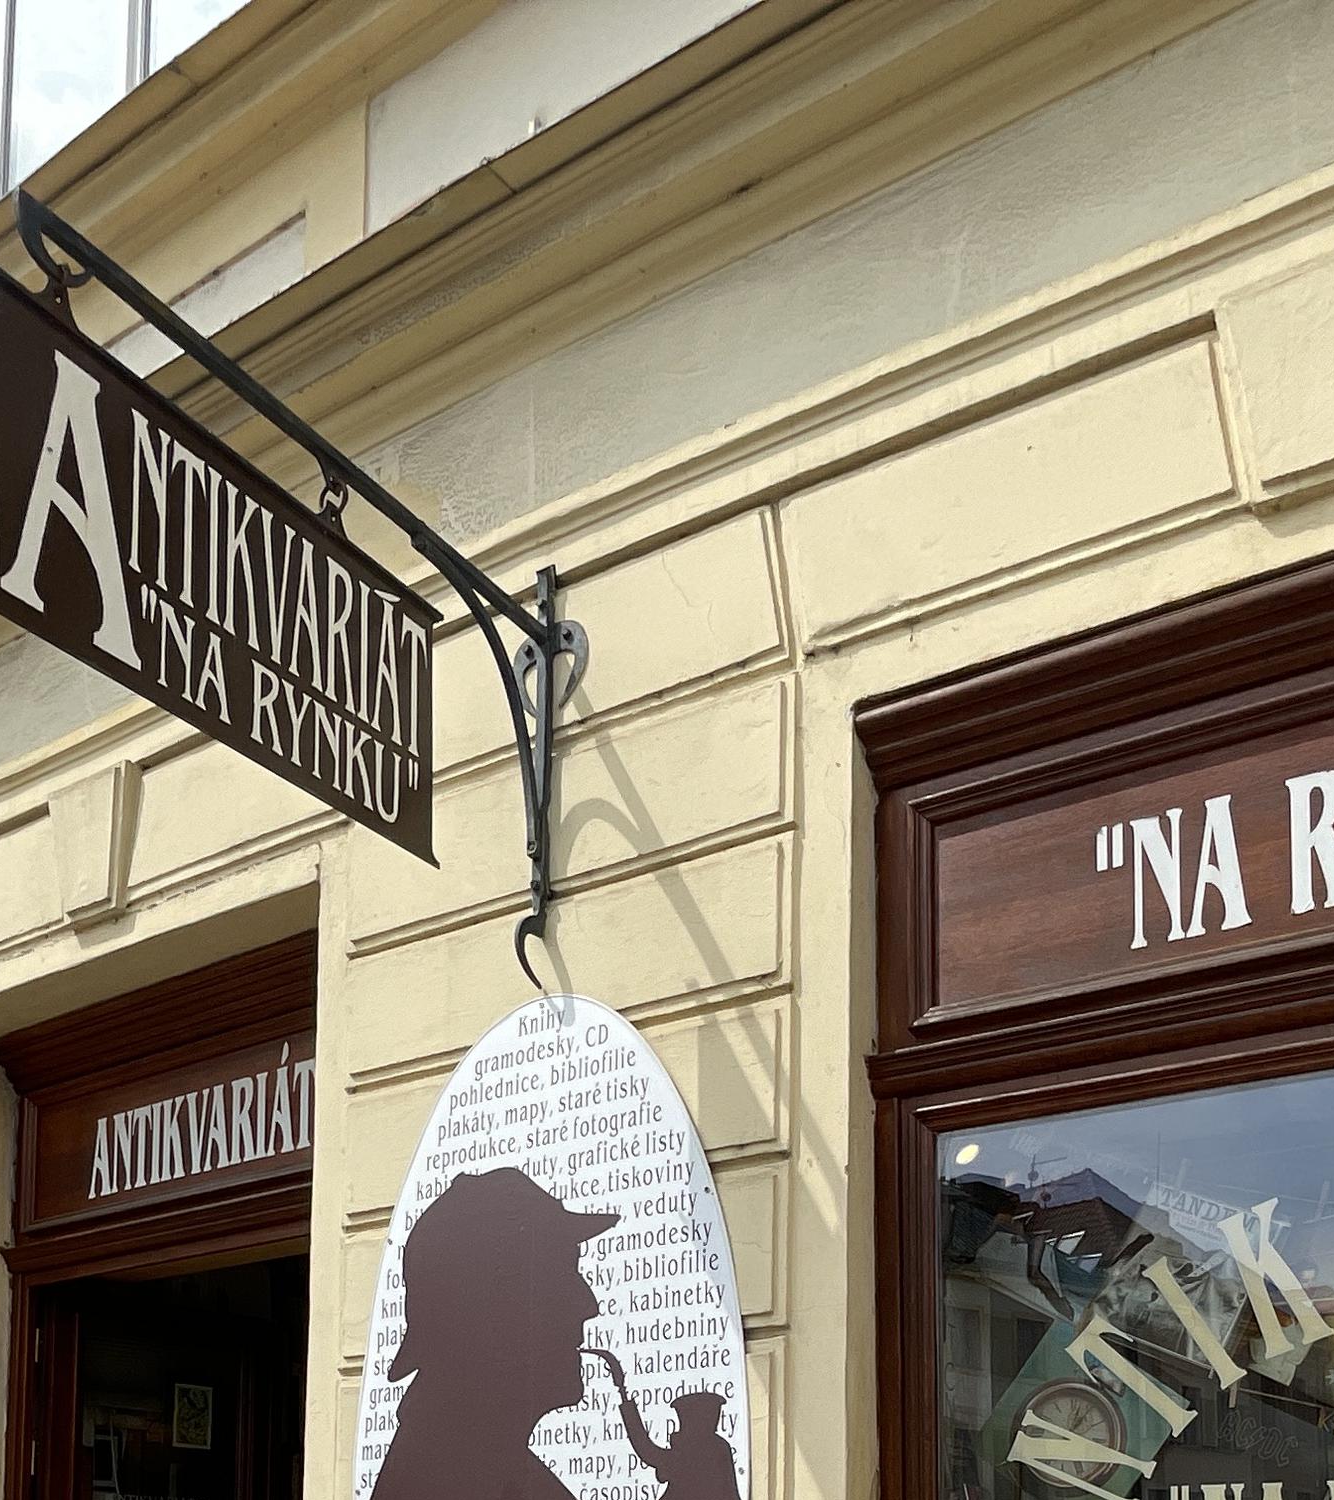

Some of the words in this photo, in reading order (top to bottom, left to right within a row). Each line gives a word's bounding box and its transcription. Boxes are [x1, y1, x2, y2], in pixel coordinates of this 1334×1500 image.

[0, 350, 429, 756] ANTIKVARIÁT
[140, 583, 231, 726] "NA
[251, 660, 420, 825] RYNKU"
[1095, 794, 1253, 950] "NA
[474, 1034, 581, 1081] gramodesky,
[584, 1022, 610, 1048] CD
[517, 1006, 566, 1038] Knihy
[437, 1106, 500, 1147] plakáty,
[504, 1100, 554, 1130] mapy,
[558, 1085, 603, 1113] staré
[605, 1073, 651, 1110] tisky
[449, 1071, 545, 1116] pohlednice,
[550, 1048, 637, 1088] bibliofilie
[88, 1041, 315, 1201] ANTIKVARIÁT
[426, 1134, 522, 1174] reprodukce,
[526, 1122, 569, 1150] staré
[572, 1100, 664, 1141] fotografie
[567, 1136, 642, 1178] grafické
[644, 1127, 687, 1160] listy
[633, 1185, 699, 1218] veduty
[629, 1281, 726, 1314] kabinetky
[625, 1313, 730, 1346] hudebniny
[633, 1346, 732, 1377] kalendáře
[568, 1454, 622, 1480] mapy,
